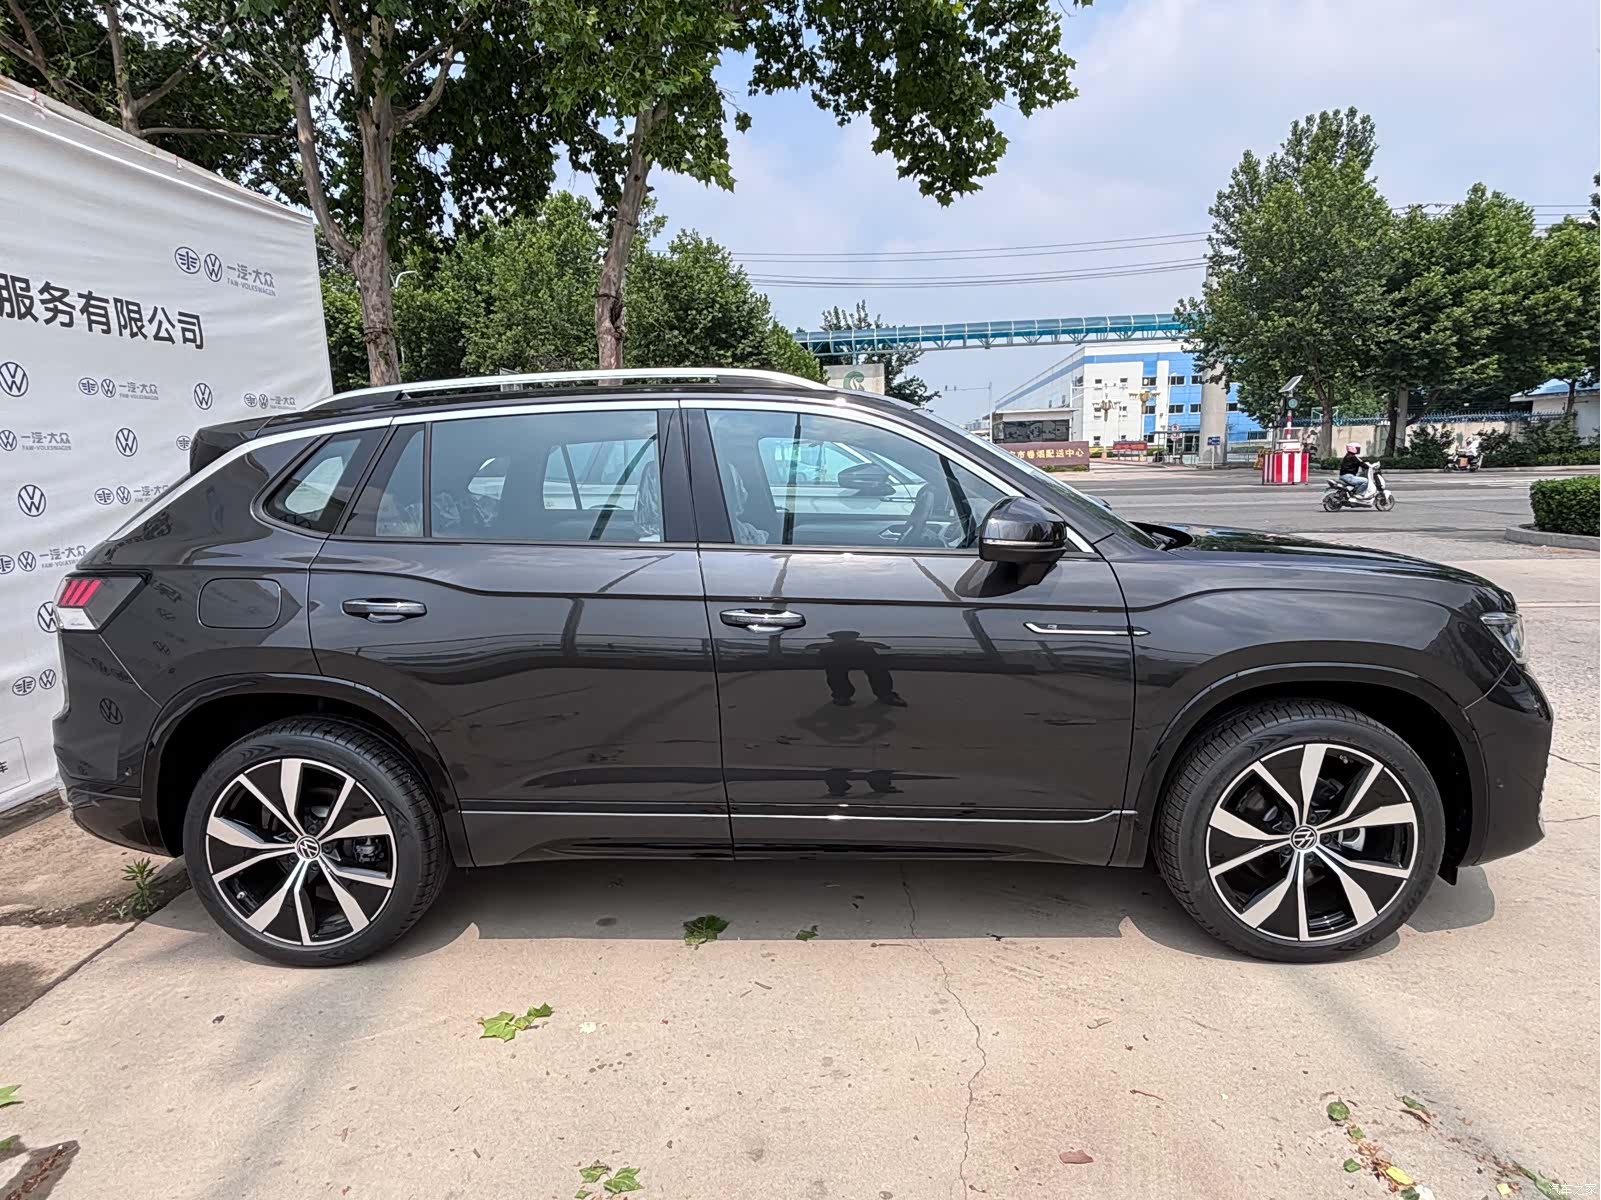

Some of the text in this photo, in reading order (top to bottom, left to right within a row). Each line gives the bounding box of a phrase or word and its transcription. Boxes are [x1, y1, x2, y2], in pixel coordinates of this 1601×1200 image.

[0, 272, 204, 350] 服务有限公司
